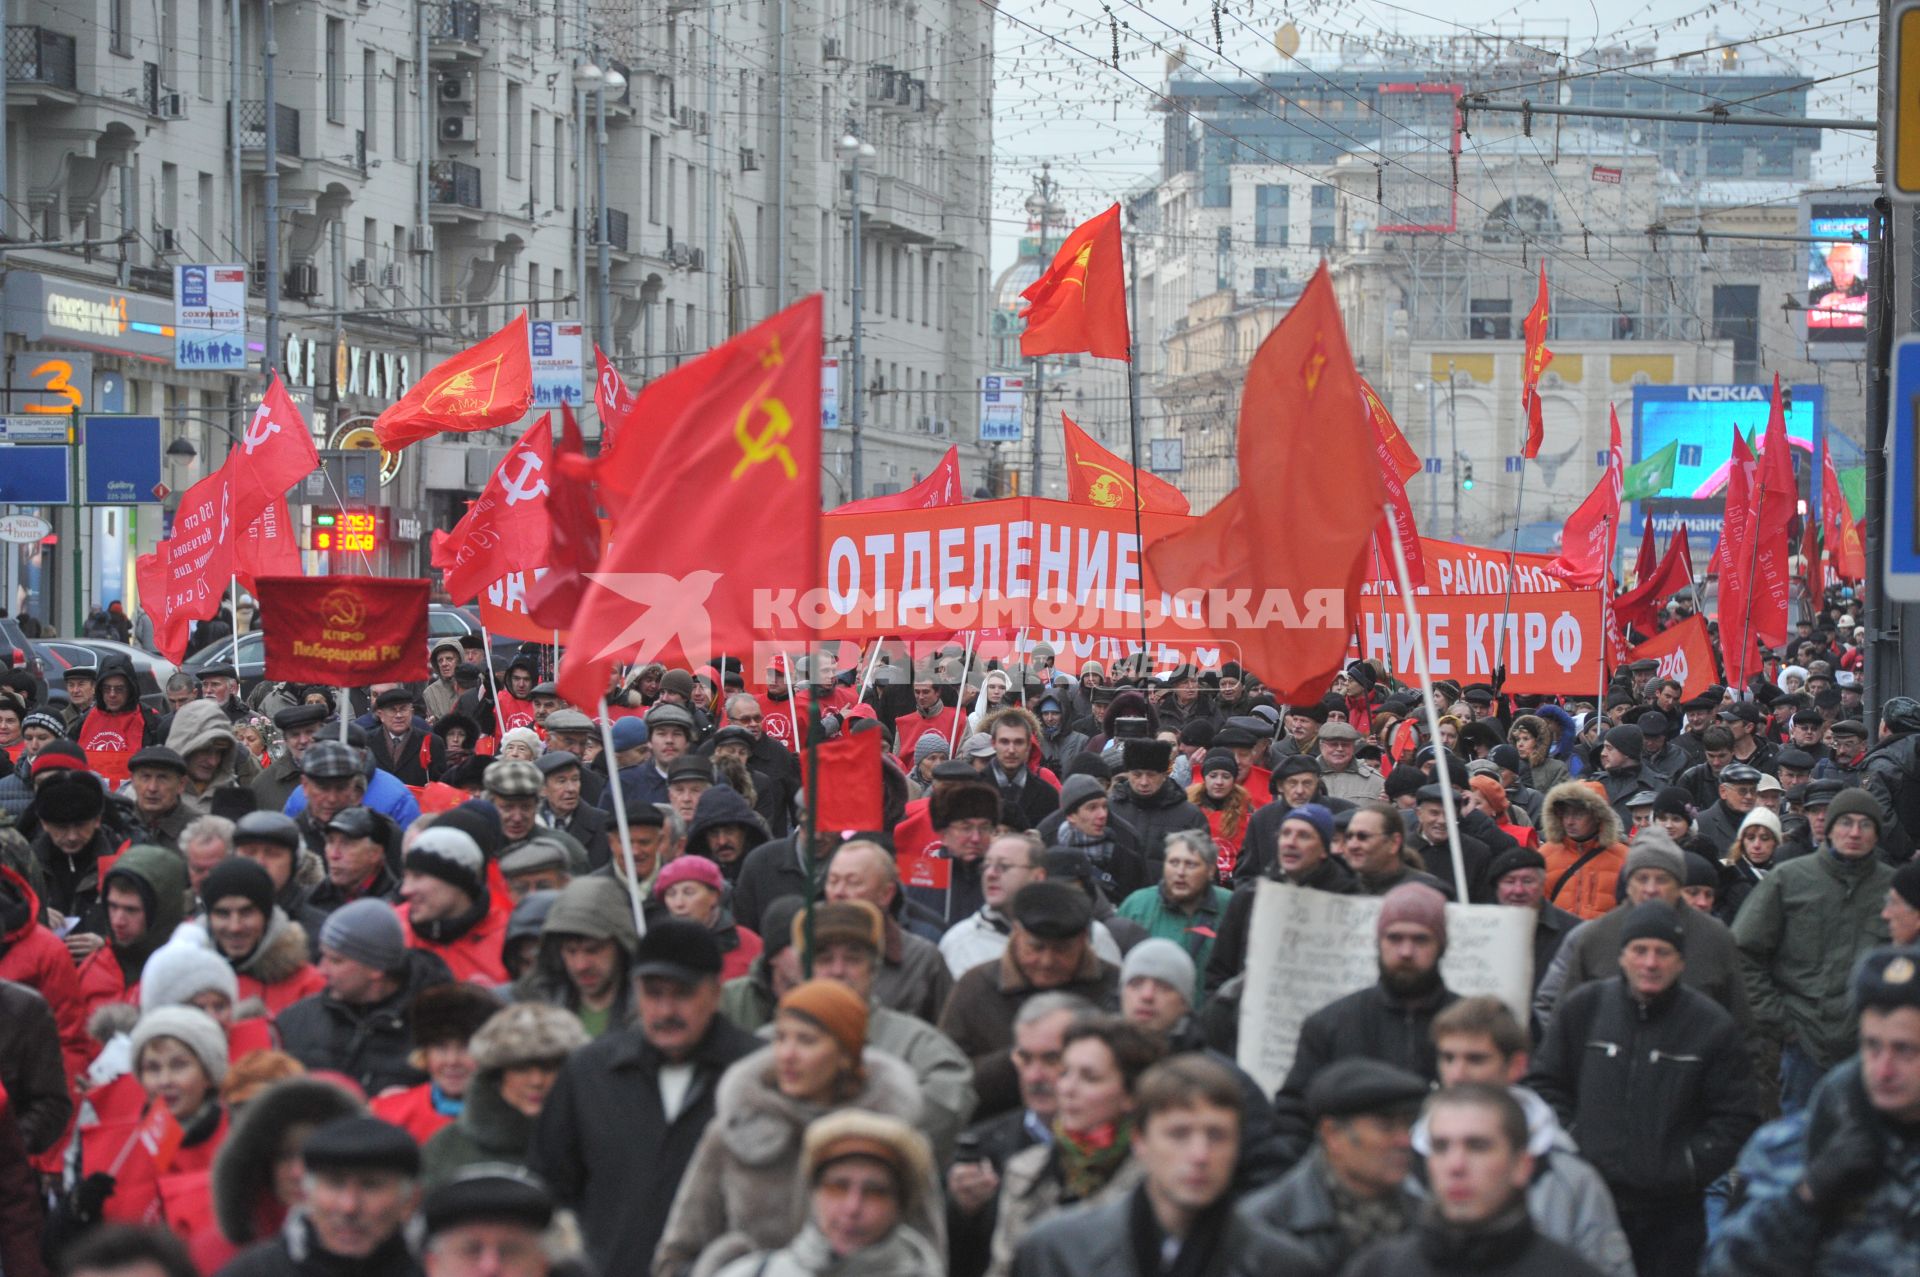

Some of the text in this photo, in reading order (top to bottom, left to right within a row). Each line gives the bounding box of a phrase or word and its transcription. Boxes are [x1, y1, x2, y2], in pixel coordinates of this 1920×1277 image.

[1687, 386, 1764, 400] NOKIA
[827, 520, 1144, 625] ОТДЕЛЕНИЕ
[322, 630, 365, 642] КПРФ
[1466, 611, 1582, 674] КПРФ
[293, 641, 400, 663] Люберецкий РК
